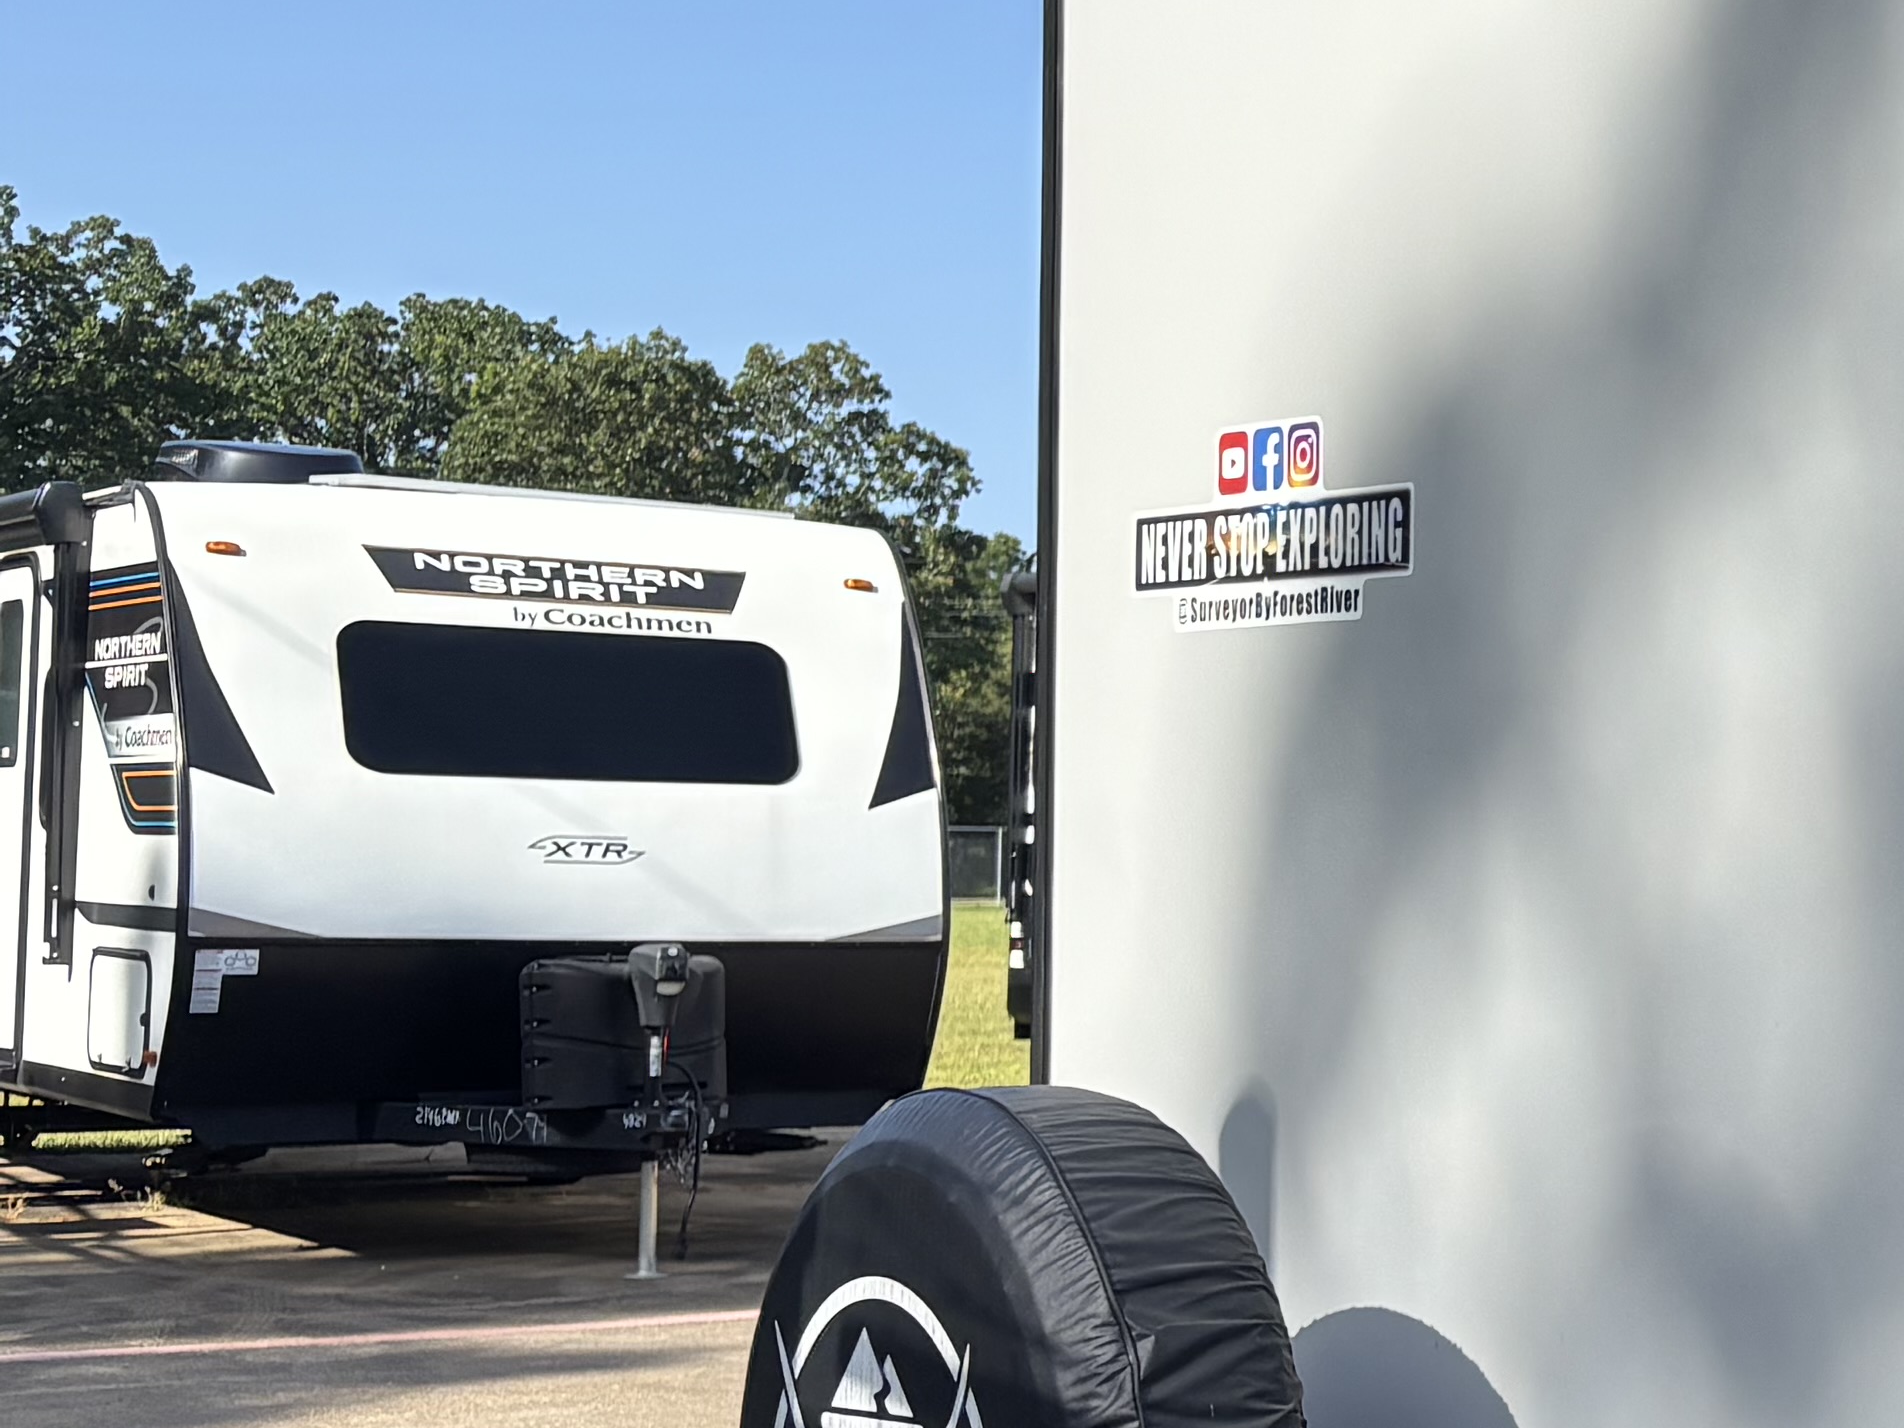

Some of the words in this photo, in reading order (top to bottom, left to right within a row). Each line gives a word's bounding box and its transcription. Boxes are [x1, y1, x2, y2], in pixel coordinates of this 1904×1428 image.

[1141, 518, 1208, 584] NEVER
[1213, 511, 1270, 578] STOP
[1276, 497, 1403, 573] EXPLORING
[412, 552, 705, 590] NORTHERN
[468, 574, 658, 604] SPIRIT
[513, 606, 538, 628] by
[543, 608, 713, 635] Coachmen
[94, 631, 162, 661] NORTHERN
[104, 662, 149, 690] SPIRIT
[124, 724, 172, 748] Coachmen
[544, 840, 628, 860] XTR
